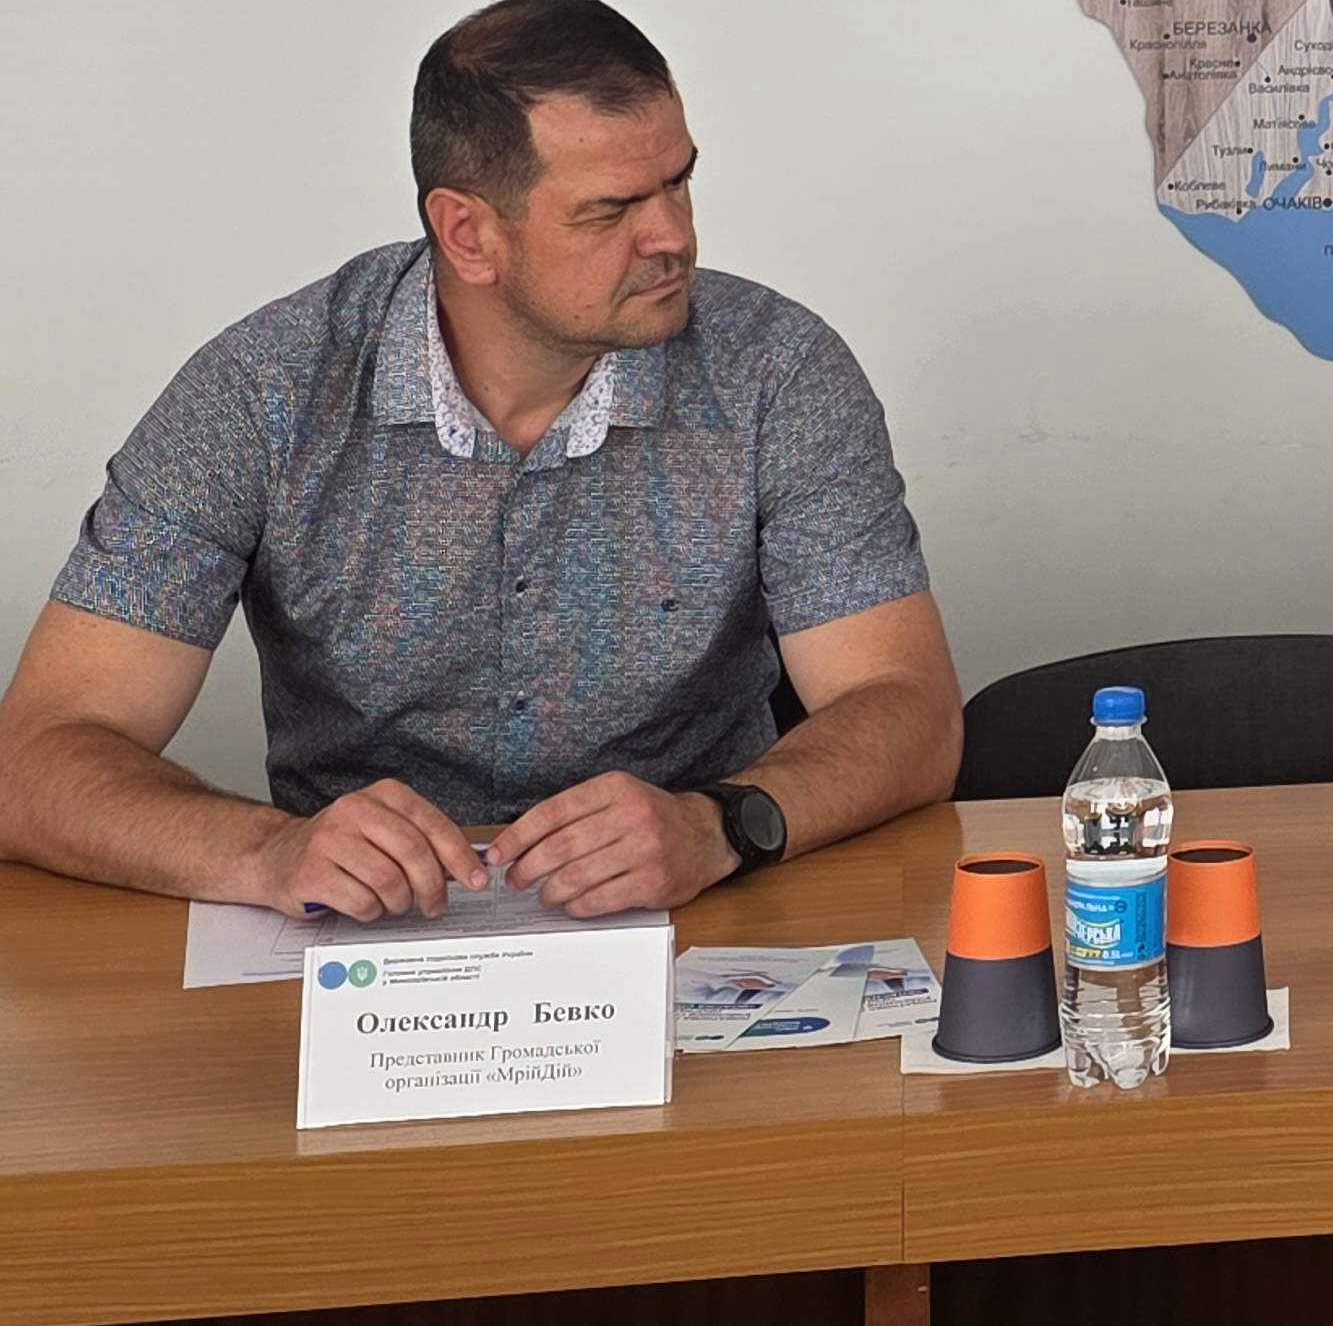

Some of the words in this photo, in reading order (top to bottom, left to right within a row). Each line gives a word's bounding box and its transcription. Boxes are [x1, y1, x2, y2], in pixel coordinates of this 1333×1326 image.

[1173, 21, 1271, 36] БЕРЕЗАНКА
[1264, 196, 1322, 211] ОЧАКІВ
[356, 1009, 508, 1034] Олександр
[533, 1001, 615, 1024] Бевко
[371, 1049, 485, 1069] Представник
[490, 1040, 600, 1062] Громадської
[385, 1071, 480, 1093] організації
[487, 1064, 582, 1085] «МрійДій»
